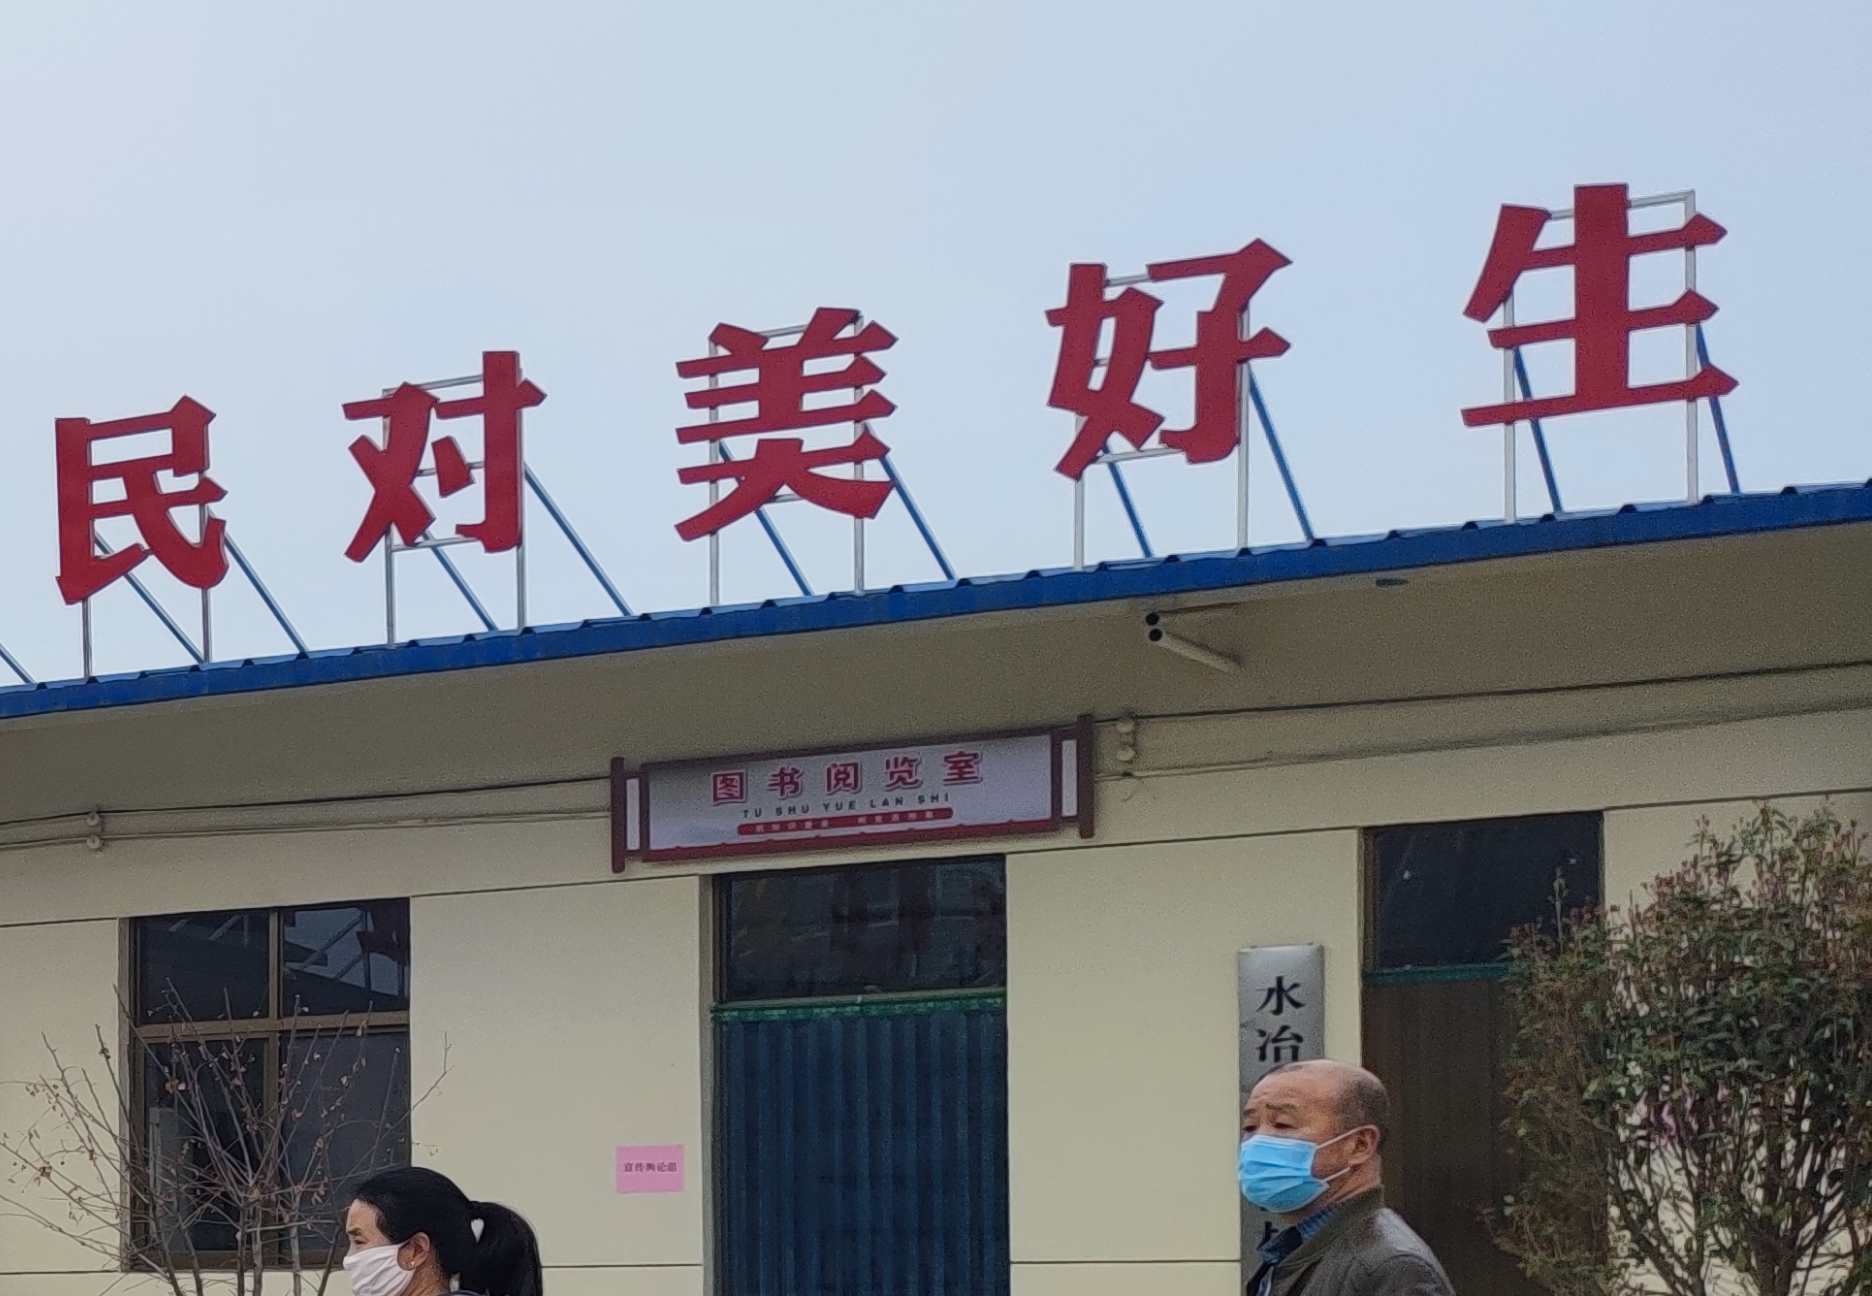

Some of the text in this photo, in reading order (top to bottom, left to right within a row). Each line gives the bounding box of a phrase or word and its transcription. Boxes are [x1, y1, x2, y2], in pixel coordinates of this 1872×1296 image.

[712, 750, 981, 803] 图书阅览室
[743, 792, 951, 819] TU SHU YUE LAN SHI
